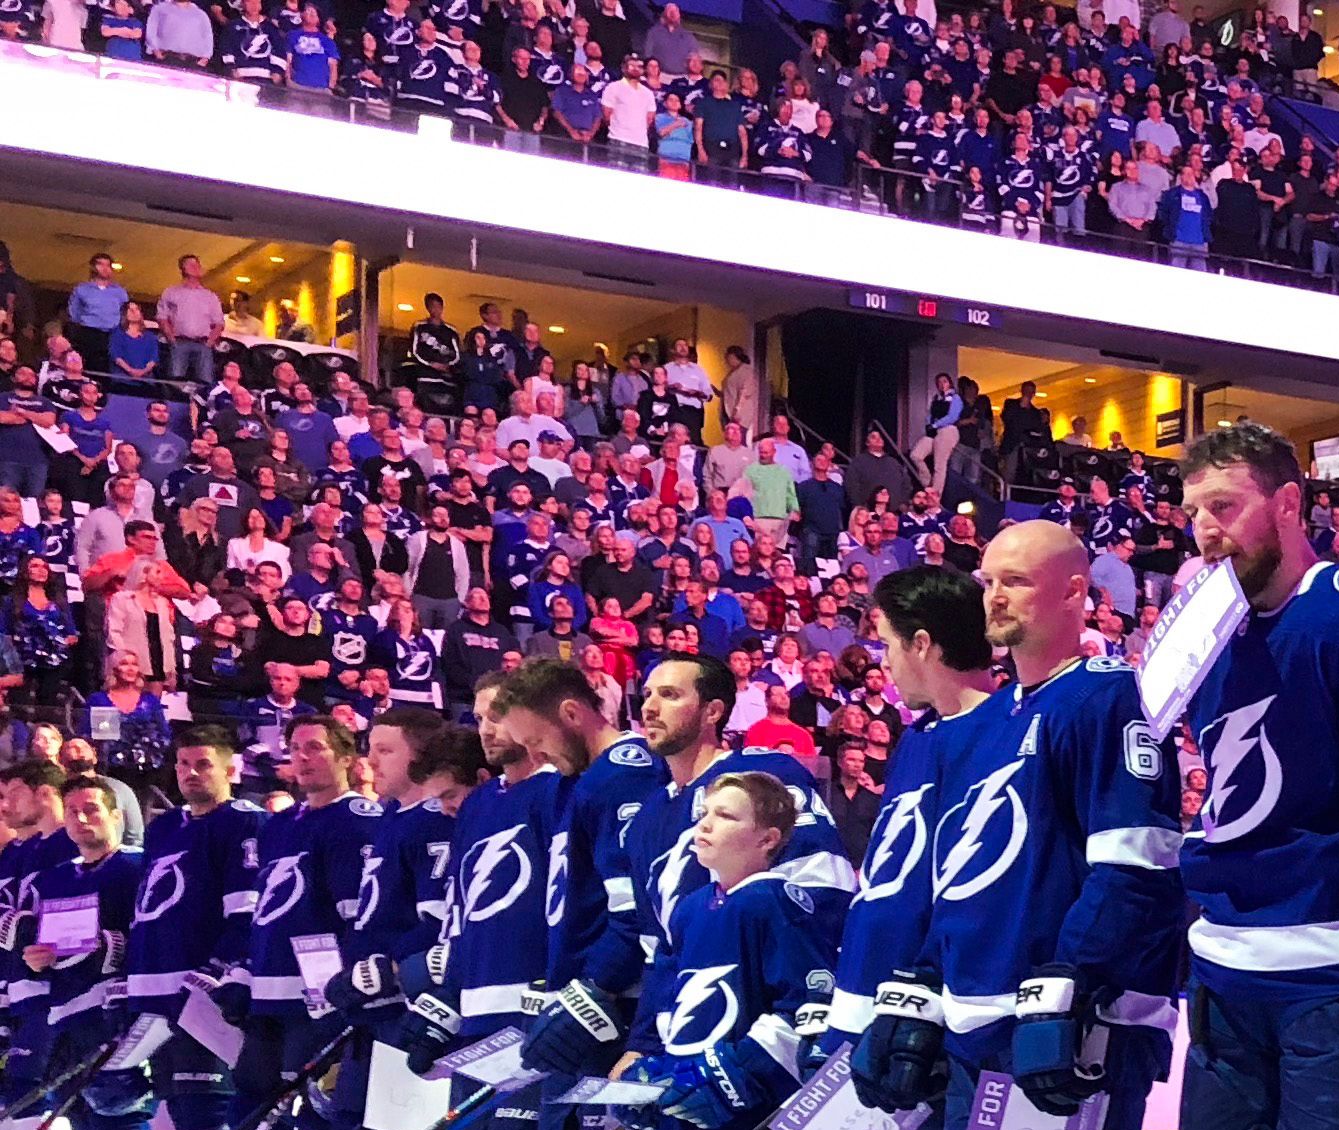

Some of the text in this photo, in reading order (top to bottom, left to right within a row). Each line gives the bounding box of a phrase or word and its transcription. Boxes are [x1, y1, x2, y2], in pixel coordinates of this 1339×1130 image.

[865, 293, 887, 310] 101
[967, 308, 990, 326] 102
[1016, 712, 1042, 757] A
[561, 986, 611, 1033] RRIOR
[705, 1050, 746, 1109] ASTON
[787, 1079, 833, 1127] FIGHT
[981, 1079, 1007, 1130] FOR
